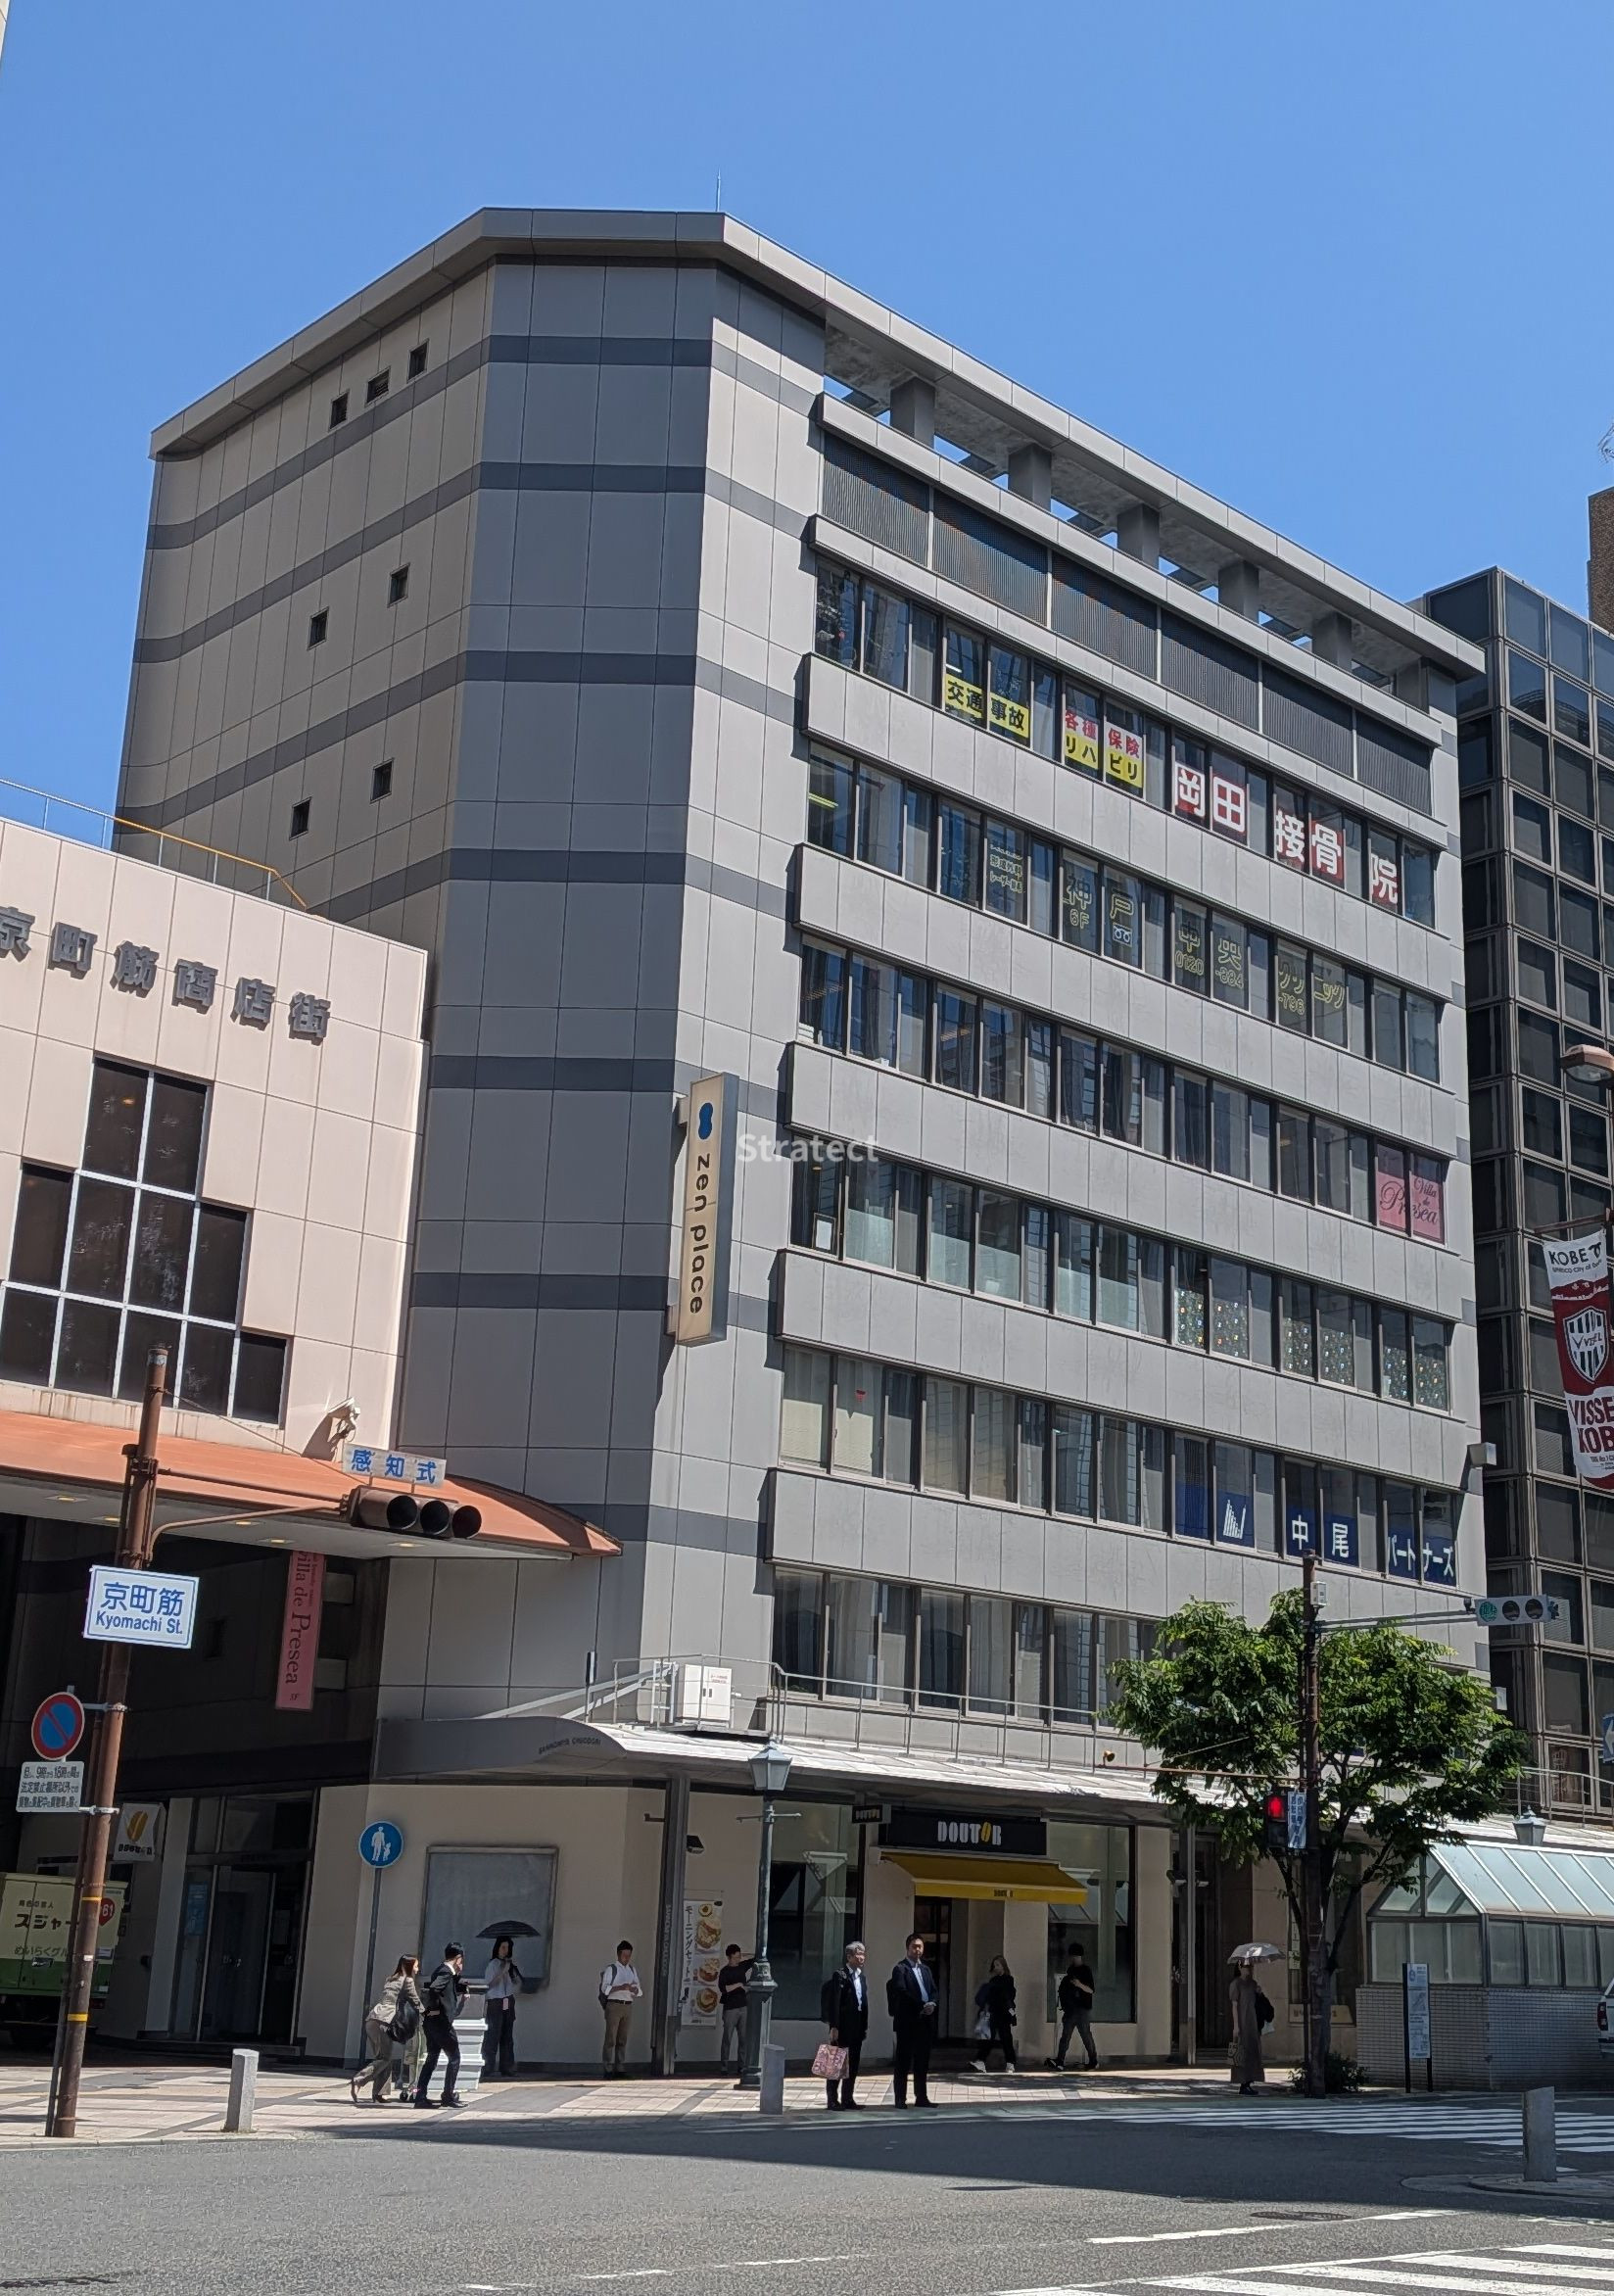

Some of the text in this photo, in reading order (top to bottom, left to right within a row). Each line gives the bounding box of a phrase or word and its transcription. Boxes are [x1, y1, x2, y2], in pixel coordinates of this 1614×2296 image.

[947, 680, 1024, 732] 交通事故
[1066, 708, 1140, 759] 各種保険
[1066, 736, 1138, 780] リハビリ
[0, 906, 331, 1045] 京町筋商店街
[689, 1153, 710, 1315] zen place
[1548, 1247, 1589, 1267] KOBE
[351, 1449, 437, 1484] 感知式
[100, 1581, 186, 1617] 京町筋
[95, 1610, 184, 1635] Kyomachi St.
[285, 1613, 311, 1685] Presea
[936, 1821, 1002, 1845] DOUTOR
